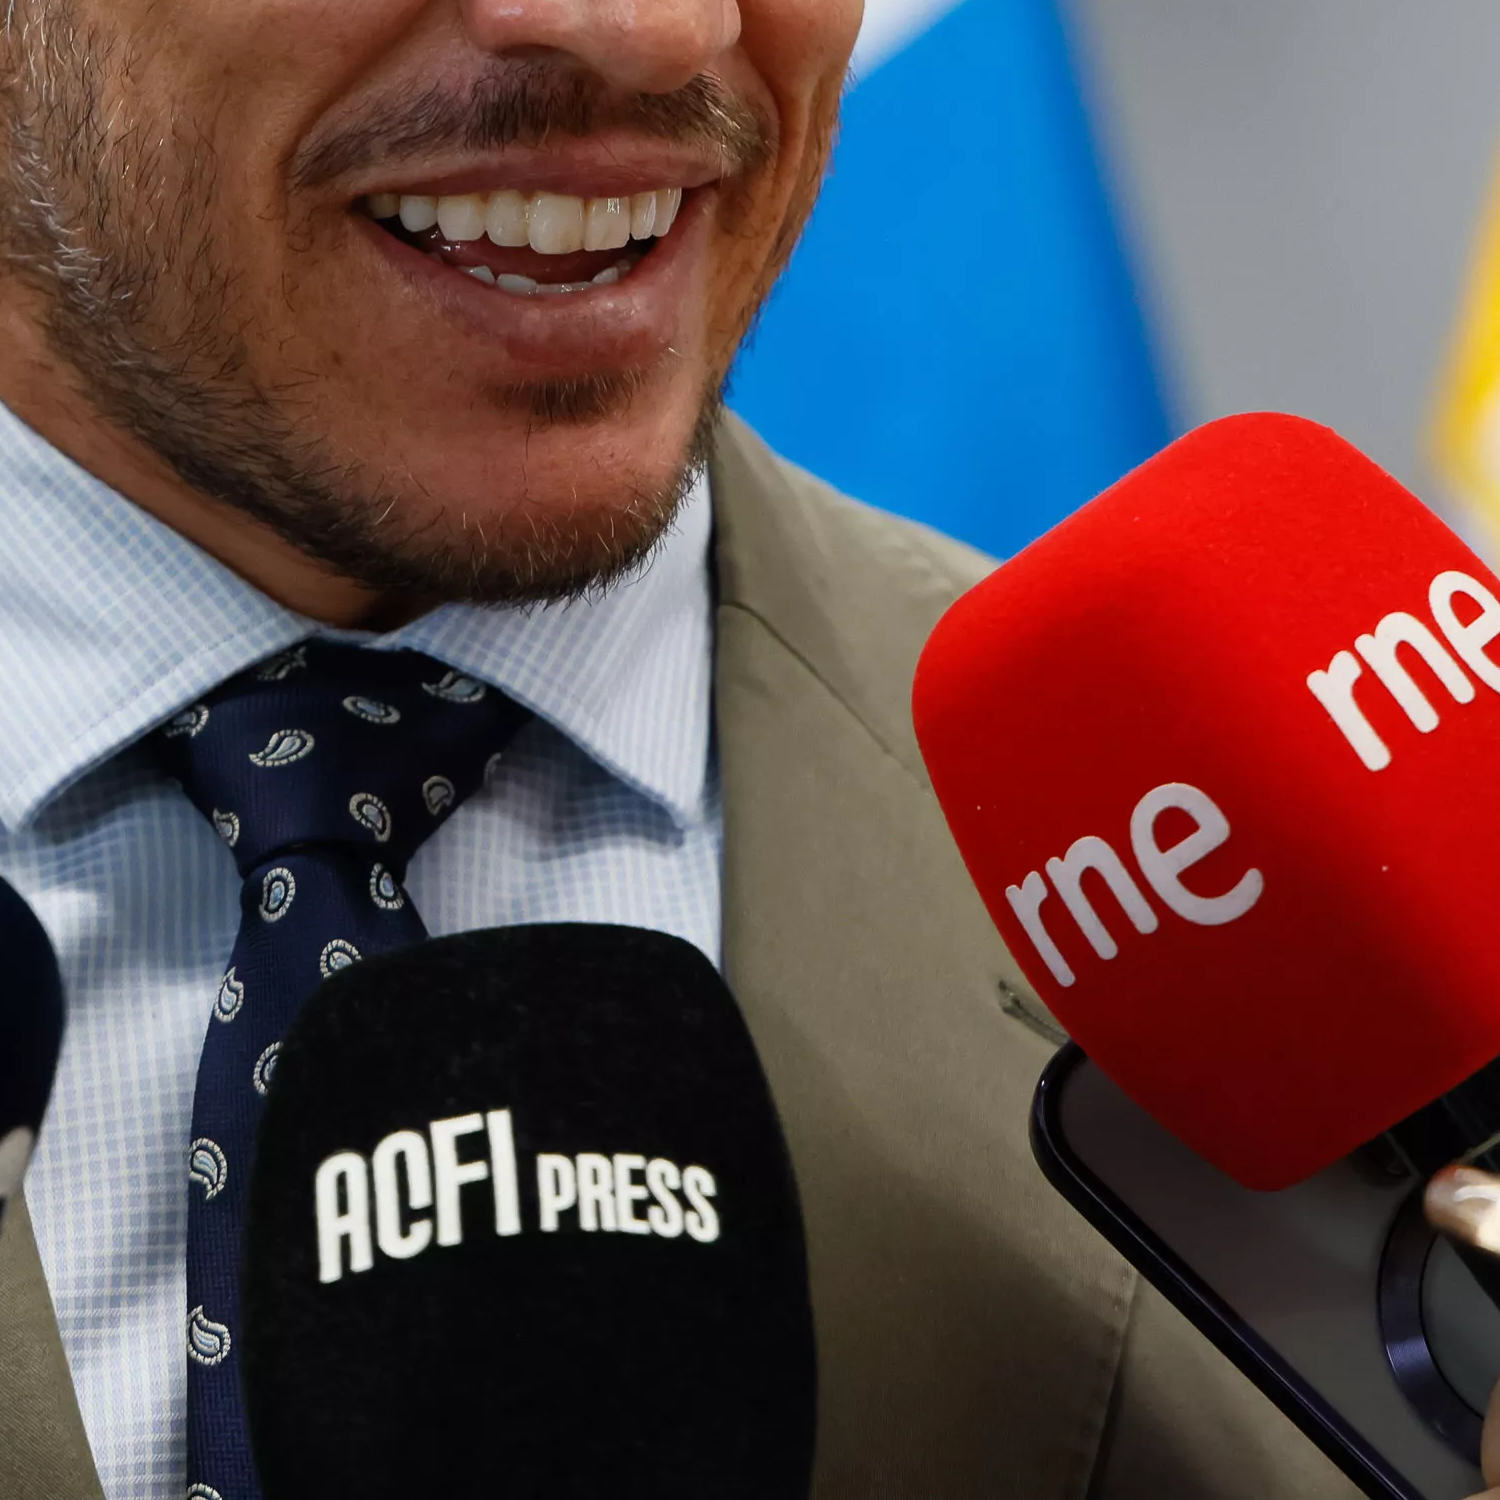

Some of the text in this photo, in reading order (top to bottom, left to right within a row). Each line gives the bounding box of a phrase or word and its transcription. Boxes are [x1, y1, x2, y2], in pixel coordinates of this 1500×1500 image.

[1005, 782, 1264, 987] rne
[315, 1108, 720, 1284] ACFI PRESS
